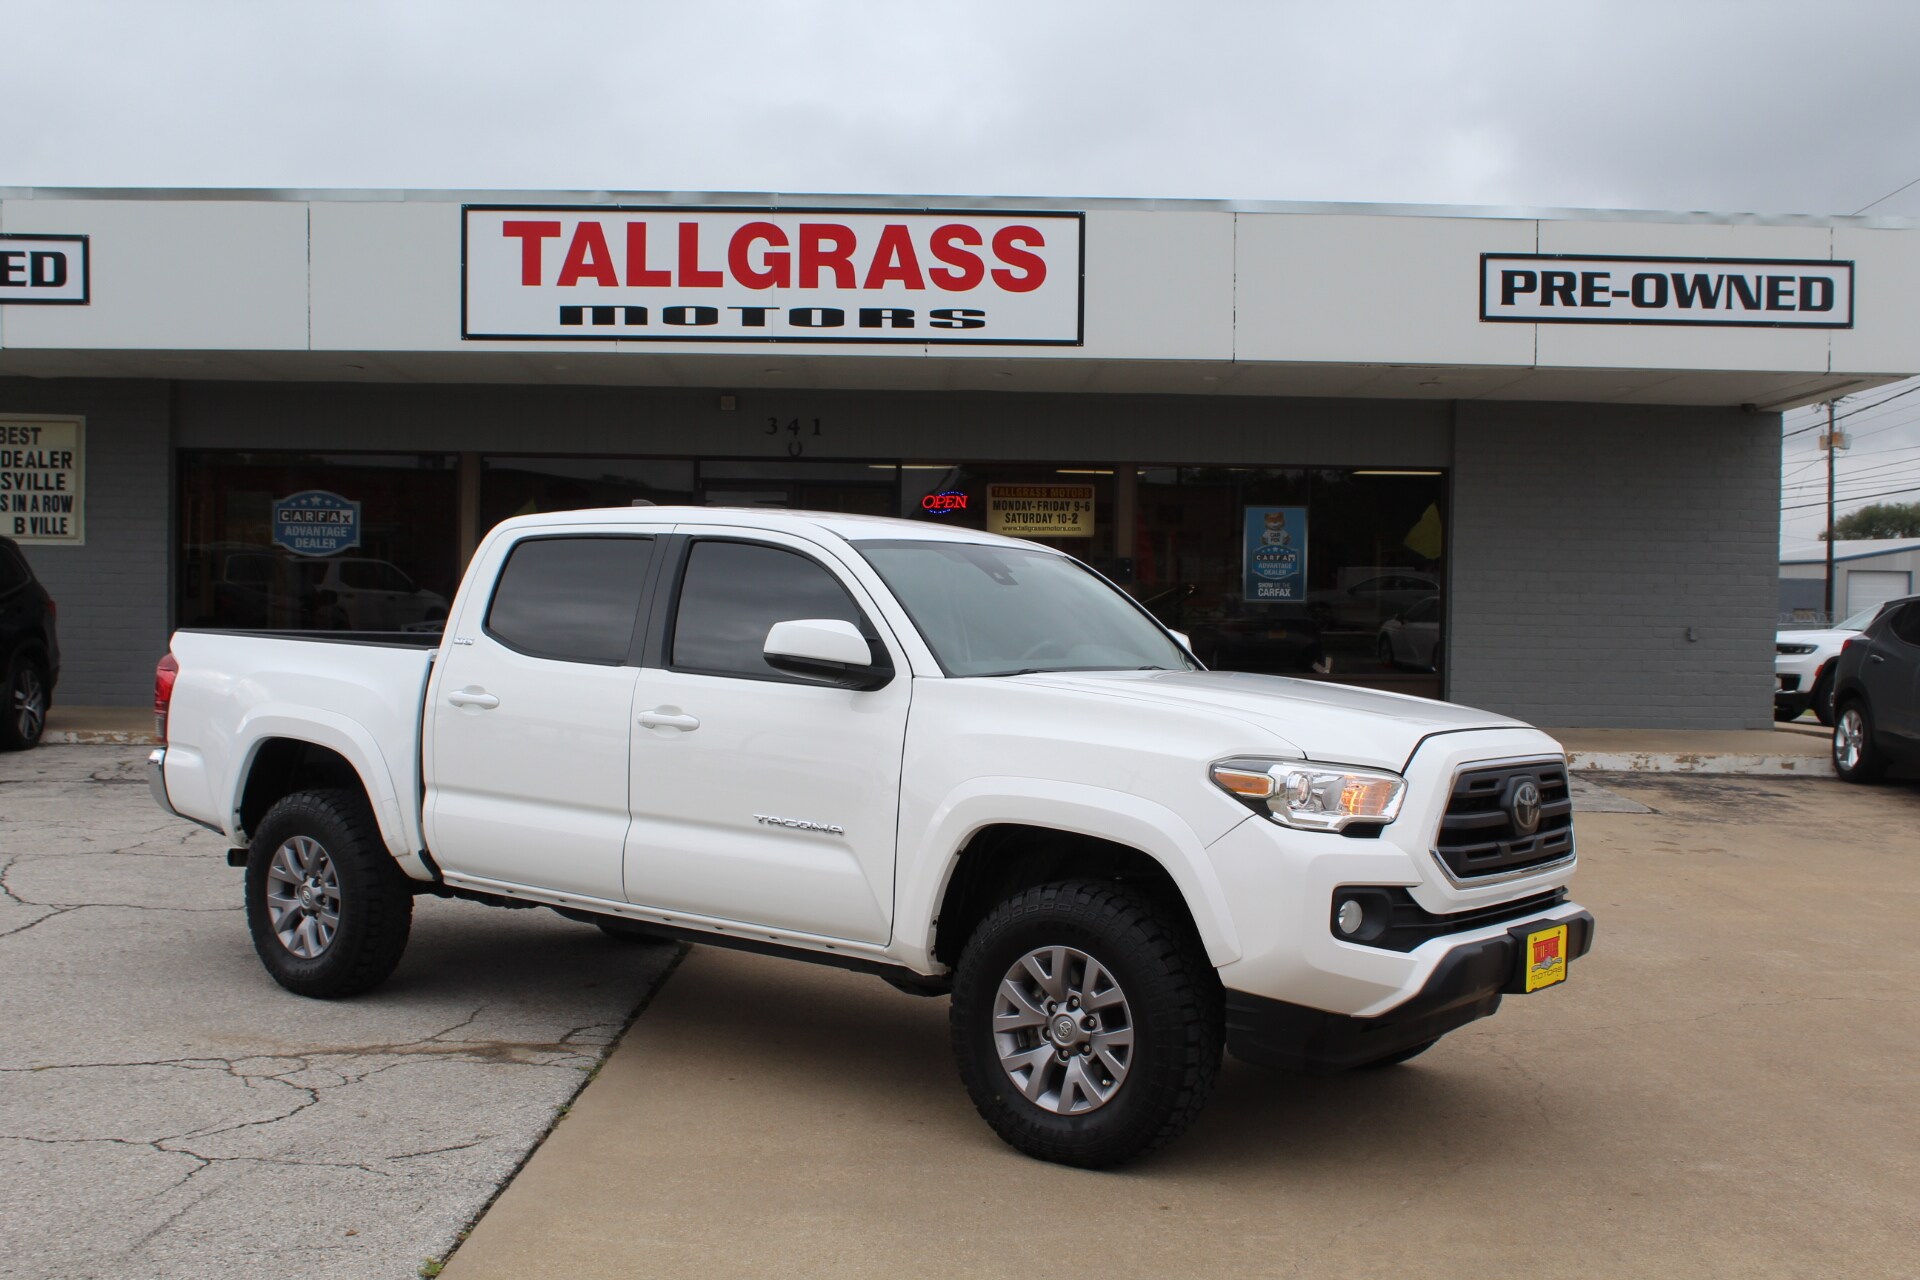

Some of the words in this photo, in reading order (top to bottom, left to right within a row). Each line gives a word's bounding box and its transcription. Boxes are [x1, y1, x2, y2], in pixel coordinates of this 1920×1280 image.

[503, 221, 1047, 292] TALLGRASS
[1500, 270, 1834, 312] PRE-OWNED
[559, 305, 986, 329] MOTORS
[1, 450, 72, 469] DEALER
[993, 487, 1047, 498] TALLGRASS
[1051, 488, 1091, 499] MOTORS
[13, 494, 26, 513] IN
[30, 494, 39, 513] A
[43, 495, 73, 513] ROW
[922, 495, 968, 509] OPEN
[993, 501, 1070, 512] MONDAY-FRIDAY
[1074, 502, 1091, 512] 9-6
[280, 510, 351, 524] CARFAX
[1005, 513, 1053, 524] SATURDAY
[1057, 514, 1078, 525] 10-2
[14, 517, 25, 534] B
[30, 517, 68, 535] VILLE
[284, 525, 347, 537] ADVANTAGE
[295, 537, 336, 549] DEALER
[1257, 588, 1291, 597] CARFAX
[753, 814, 844, 836] TACOMA
